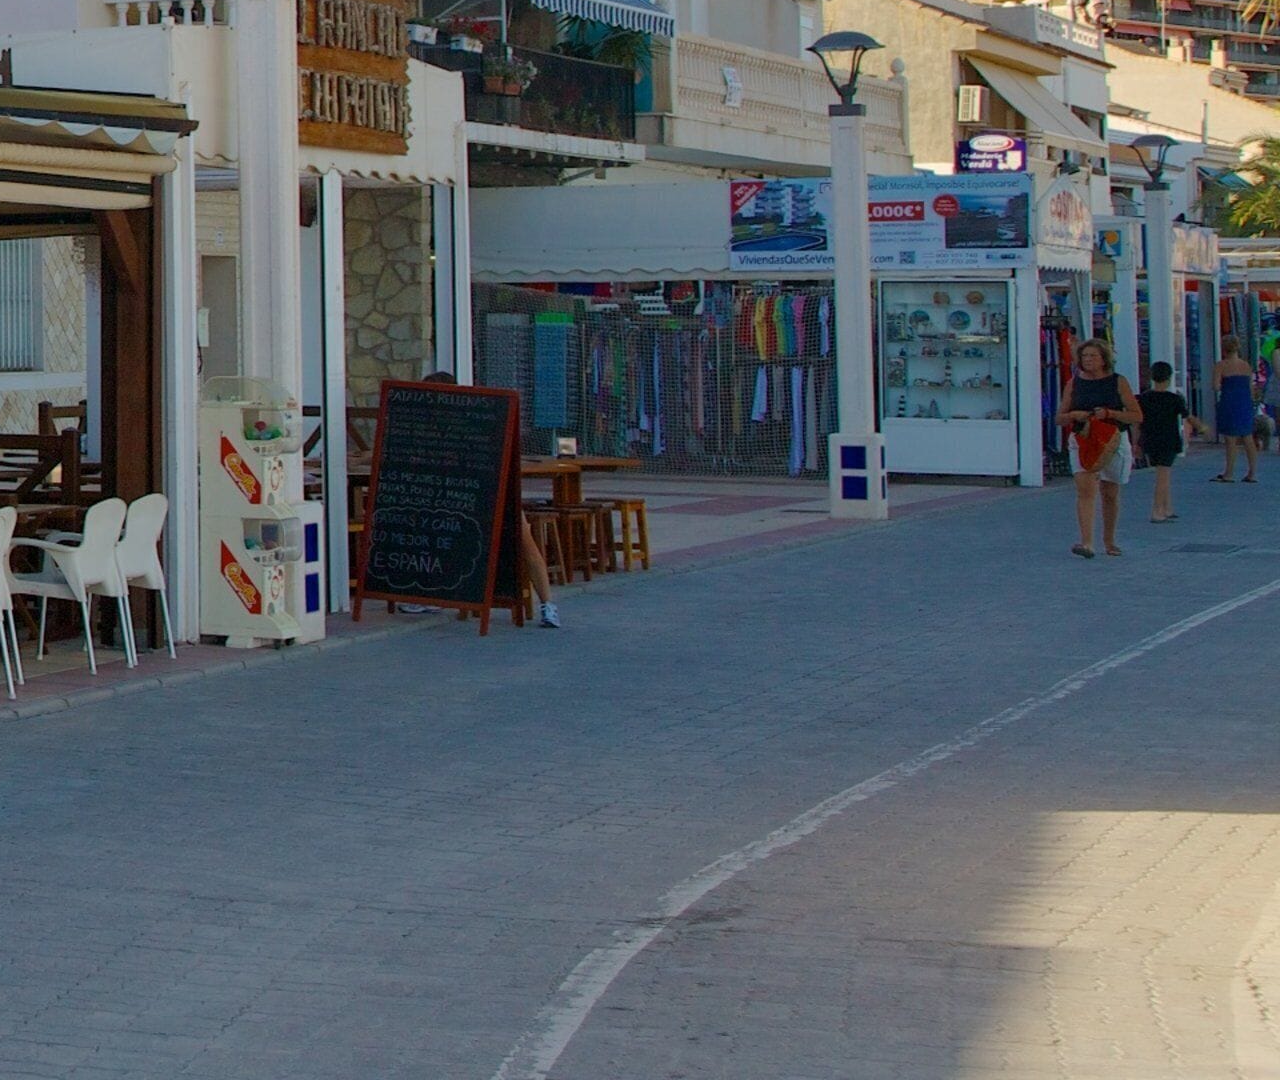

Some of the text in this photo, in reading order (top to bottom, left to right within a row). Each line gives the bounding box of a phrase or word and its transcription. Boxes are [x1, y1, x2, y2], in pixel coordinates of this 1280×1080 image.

[420, 516, 429, 528] Y
[431, 517, 462, 533] CAÑA
[391, 532, 430, 547] MEJOR
[436, 536, 453, 550] DE
[374, 550, 444, 574] ESPAÑA
